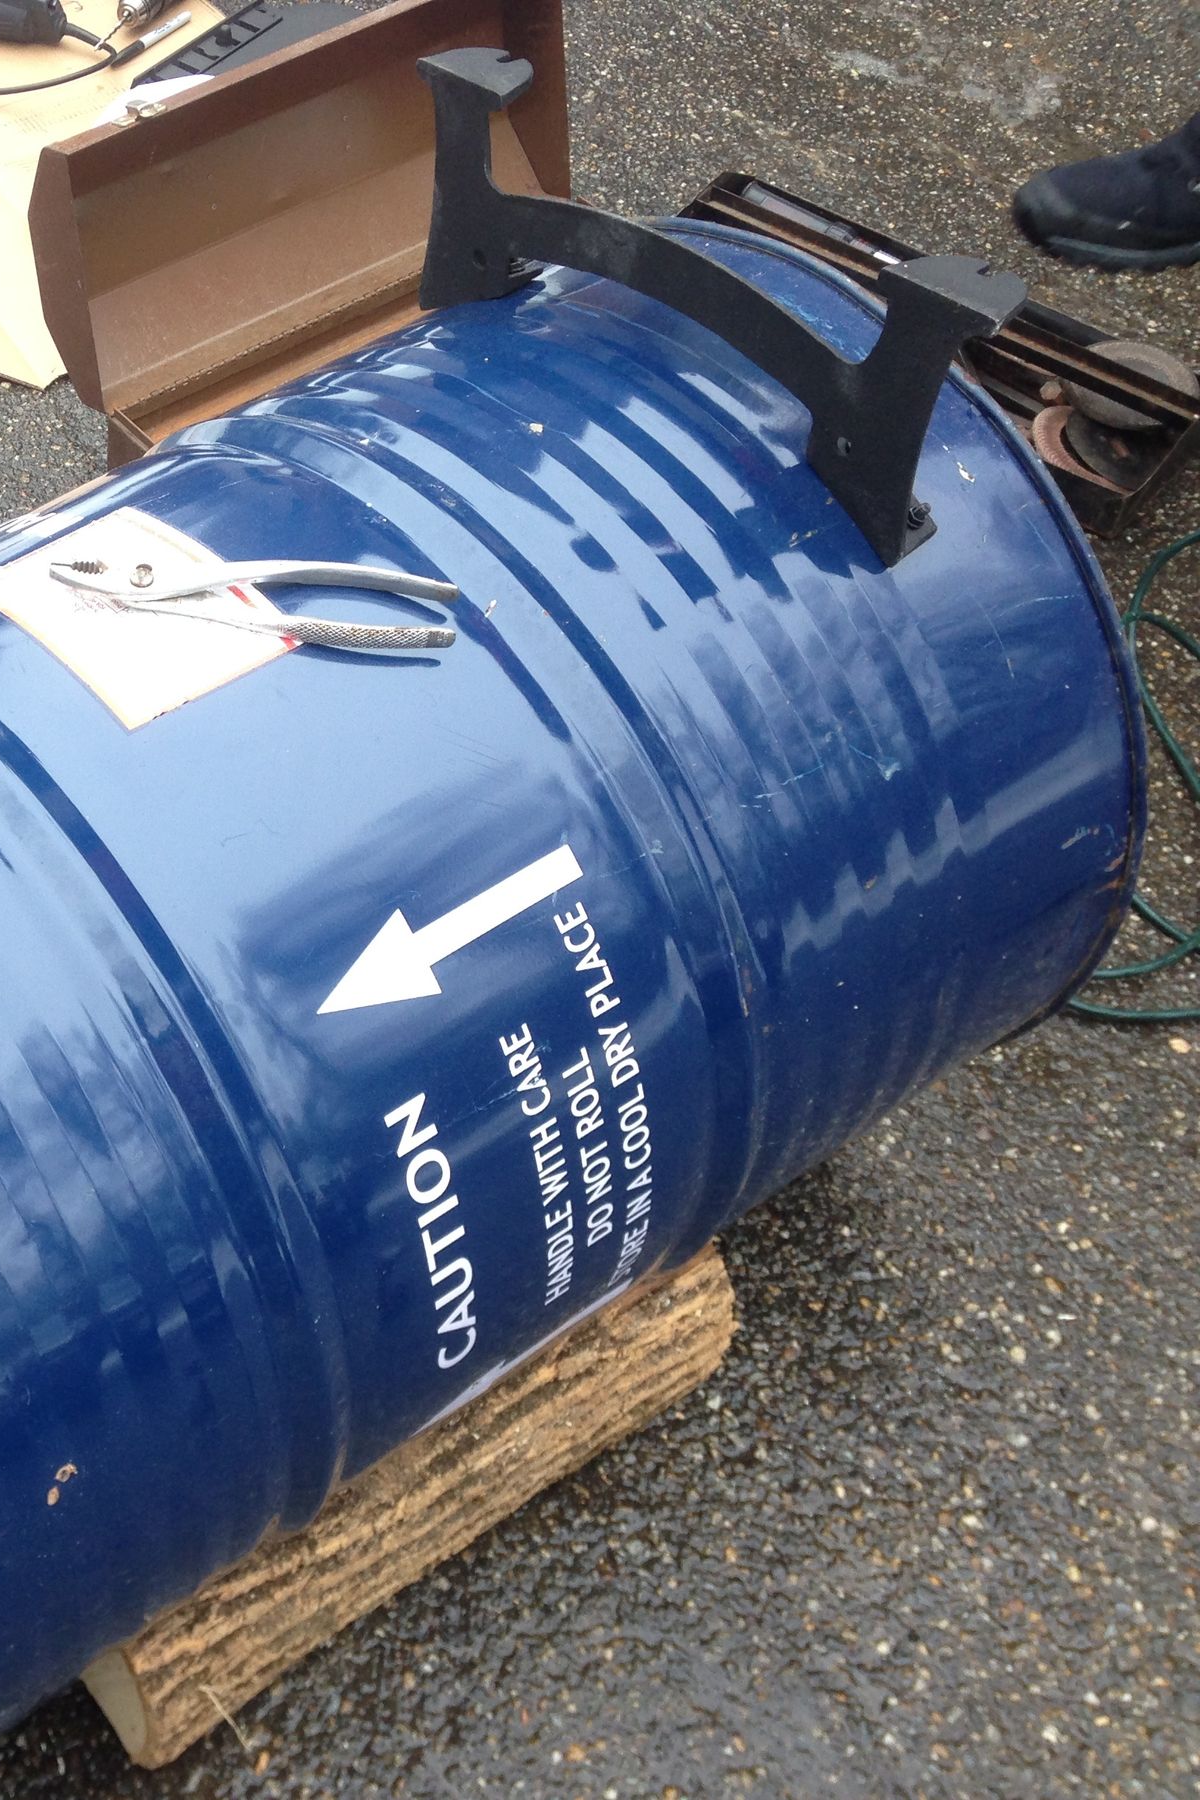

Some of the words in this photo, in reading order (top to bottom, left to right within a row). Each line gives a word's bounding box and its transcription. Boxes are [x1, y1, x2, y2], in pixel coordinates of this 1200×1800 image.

[553, 901, 621, 1018] PLACE
[499, 1022, 551, 1116] CARE
[562, 1046, 604, 1139] ROLL
[598, 1021, 640, 1088] DRY
[529, 1116, 569, 1207] WITH
[618, 1082, 651, 1170] COOL
[580, 1141, 612, 1205] NOT
[626, 1165, 652, 1191] A
[626, 1188, 652, 1225] IN
[384, 1092, 477, 1369] CAUTION
[544, 1200, 574, 1306] HANDLE
[587, 1203, 613, 1247] DO
